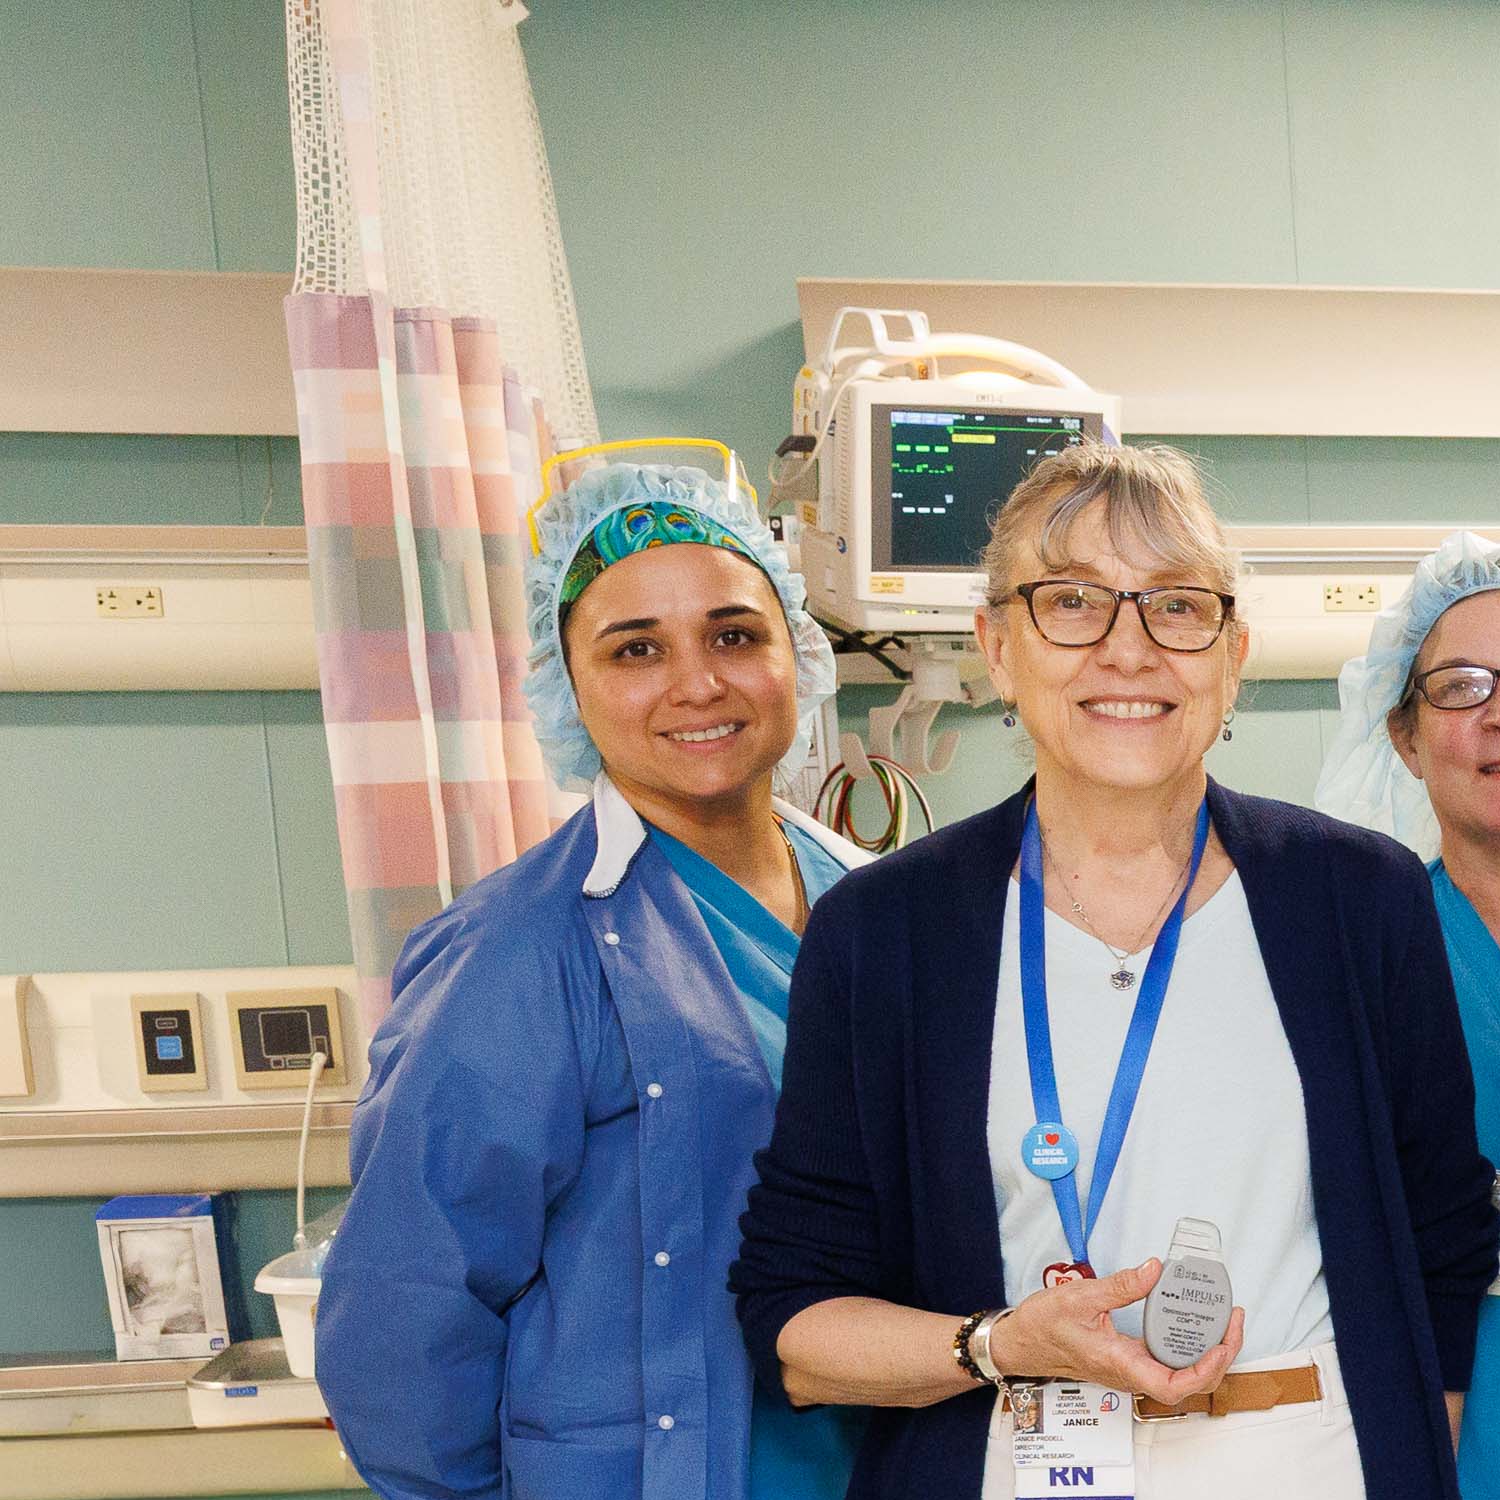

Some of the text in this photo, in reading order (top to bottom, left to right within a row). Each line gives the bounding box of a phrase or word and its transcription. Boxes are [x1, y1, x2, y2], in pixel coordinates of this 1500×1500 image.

[1036, 1134, 1044, 1145] I
[1181, 1288, 1225, 1304] IMPULSE
[1063, 1418, 1099, 1427] JANICE
[1049, 1467, 1094, 1486] RN
